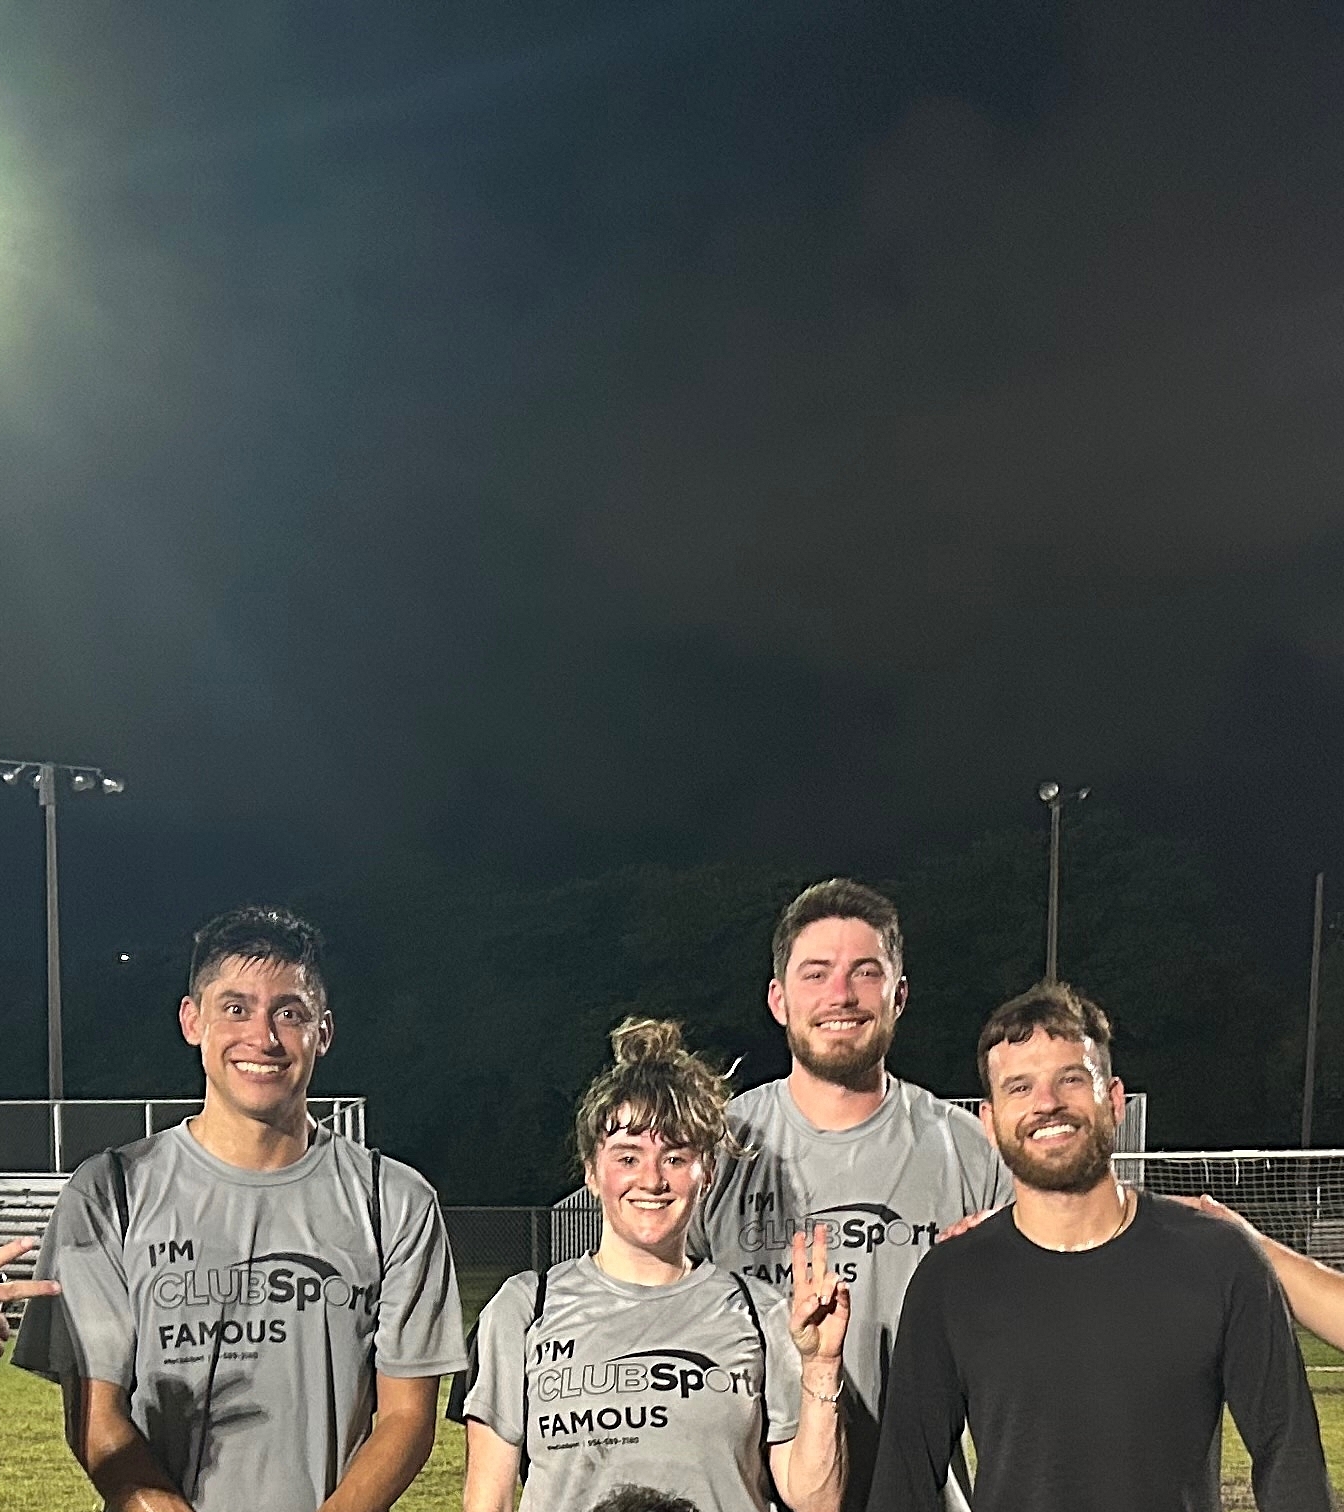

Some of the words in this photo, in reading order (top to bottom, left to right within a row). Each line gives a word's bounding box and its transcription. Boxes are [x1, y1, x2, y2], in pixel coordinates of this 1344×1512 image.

[739, 1191, 775, 1216] I'M
[148, 1239, 194, 1268] I'M
[158, 1319, 287, 1350] FAMOUS
[535, 1338, 576, 1365] I'M
[538, 1405, 669, 1439] FAMOUS
